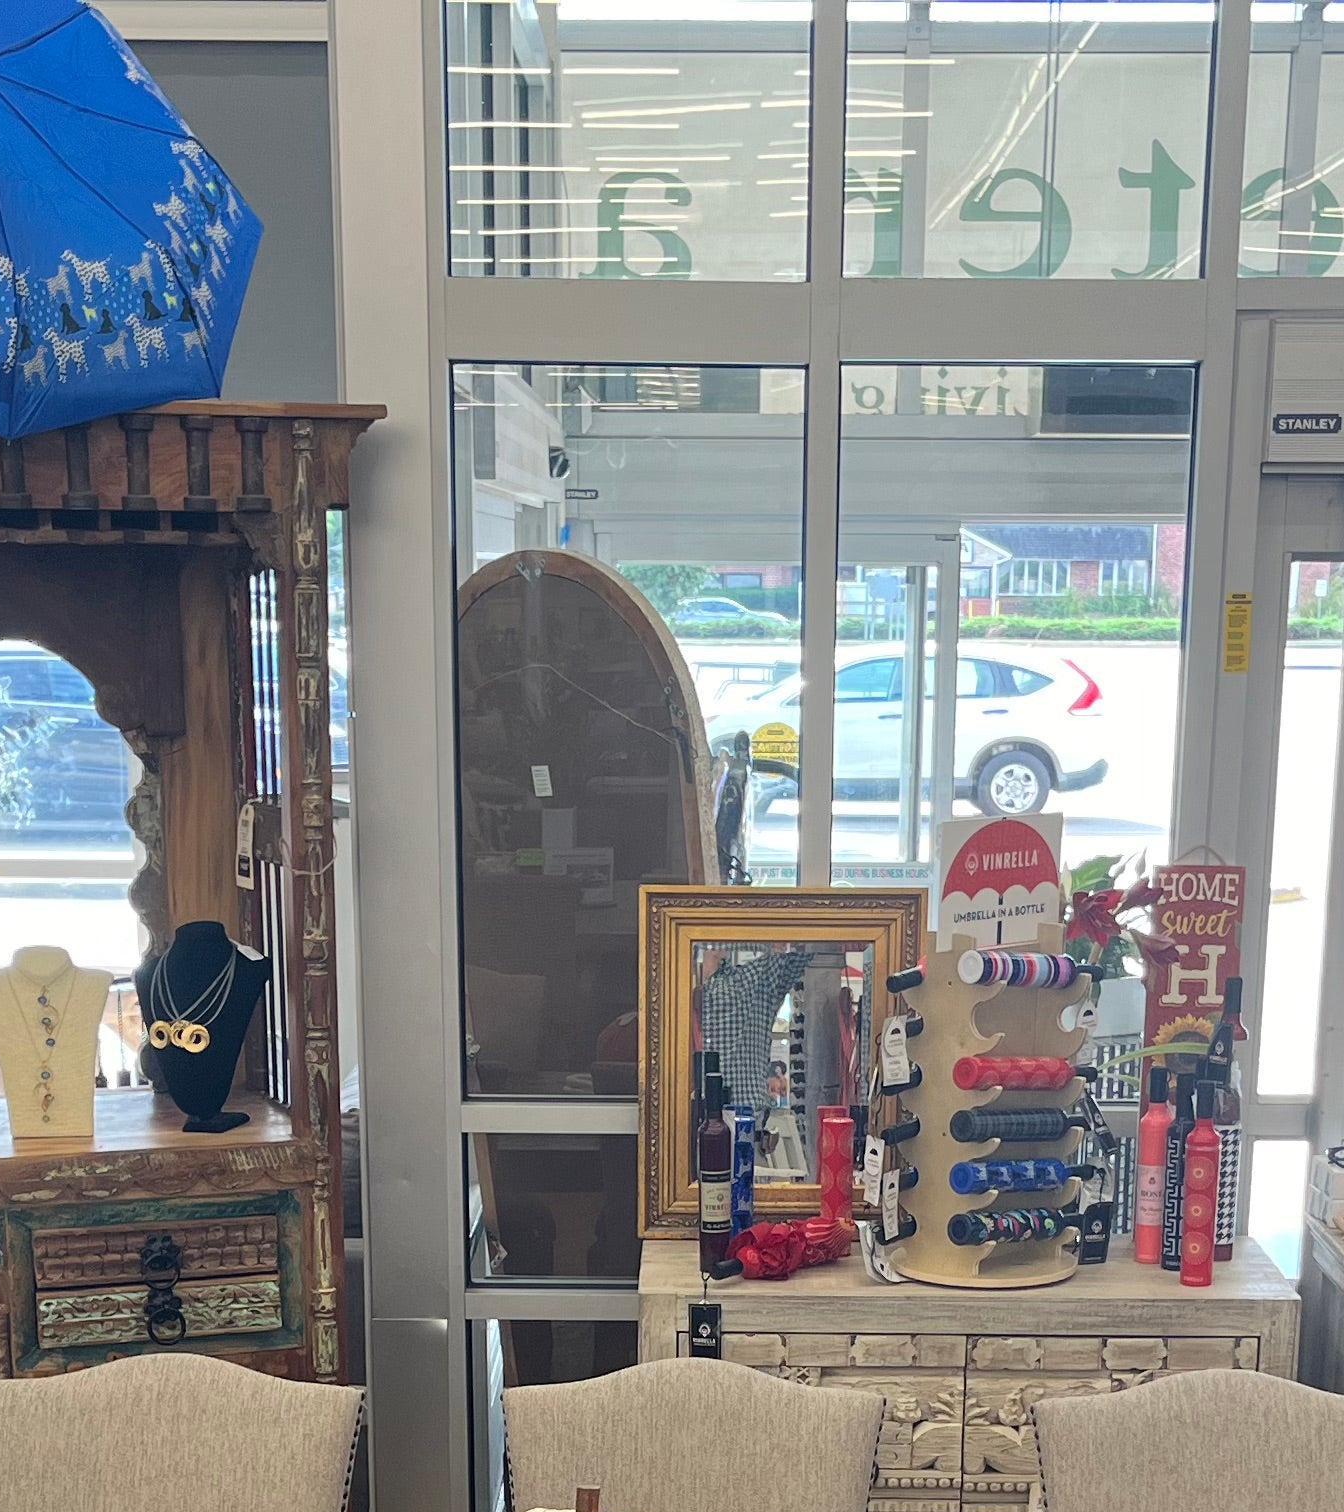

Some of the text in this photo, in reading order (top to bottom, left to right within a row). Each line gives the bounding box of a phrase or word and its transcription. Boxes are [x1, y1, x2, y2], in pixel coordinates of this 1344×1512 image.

[1277, 417, 1337, 430] STANLEY
[982, 849, 1039, 871] VINRELLA
[871, 868, 904, 878] BUSINESS
[1156, 872, 1240, 907] HOME
[953, 903, 1046, 924] UMBRELLA IN A BOTTLE
[1161, 944, 1227, 1005] H
